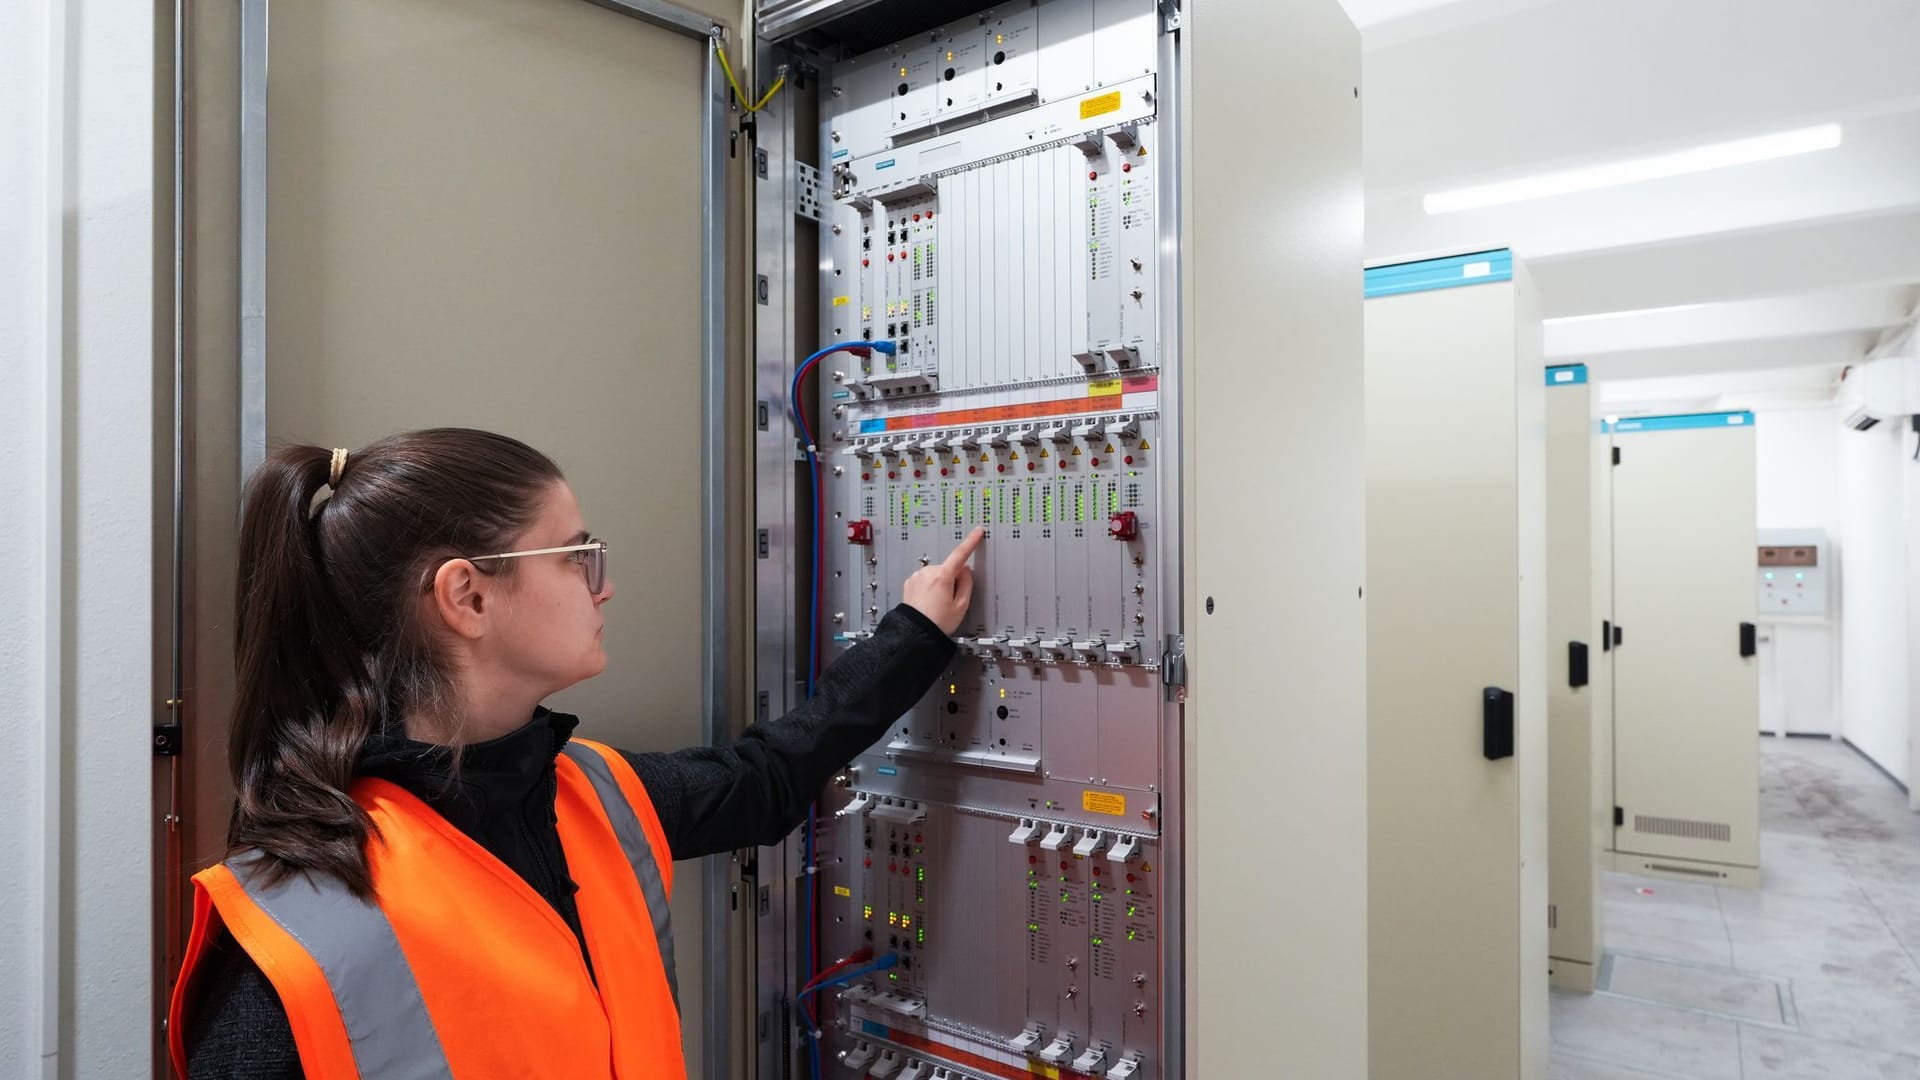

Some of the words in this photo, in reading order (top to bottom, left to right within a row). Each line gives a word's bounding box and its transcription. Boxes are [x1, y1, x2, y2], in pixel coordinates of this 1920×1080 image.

[759, 152, 767, 174] B
[759, 279, 768, 301] C
[759, 405, 768, 426] D
[760, 533, 767, 554] E
[760, 695, 767, 717] F
[760, 889, 769, 912] H
